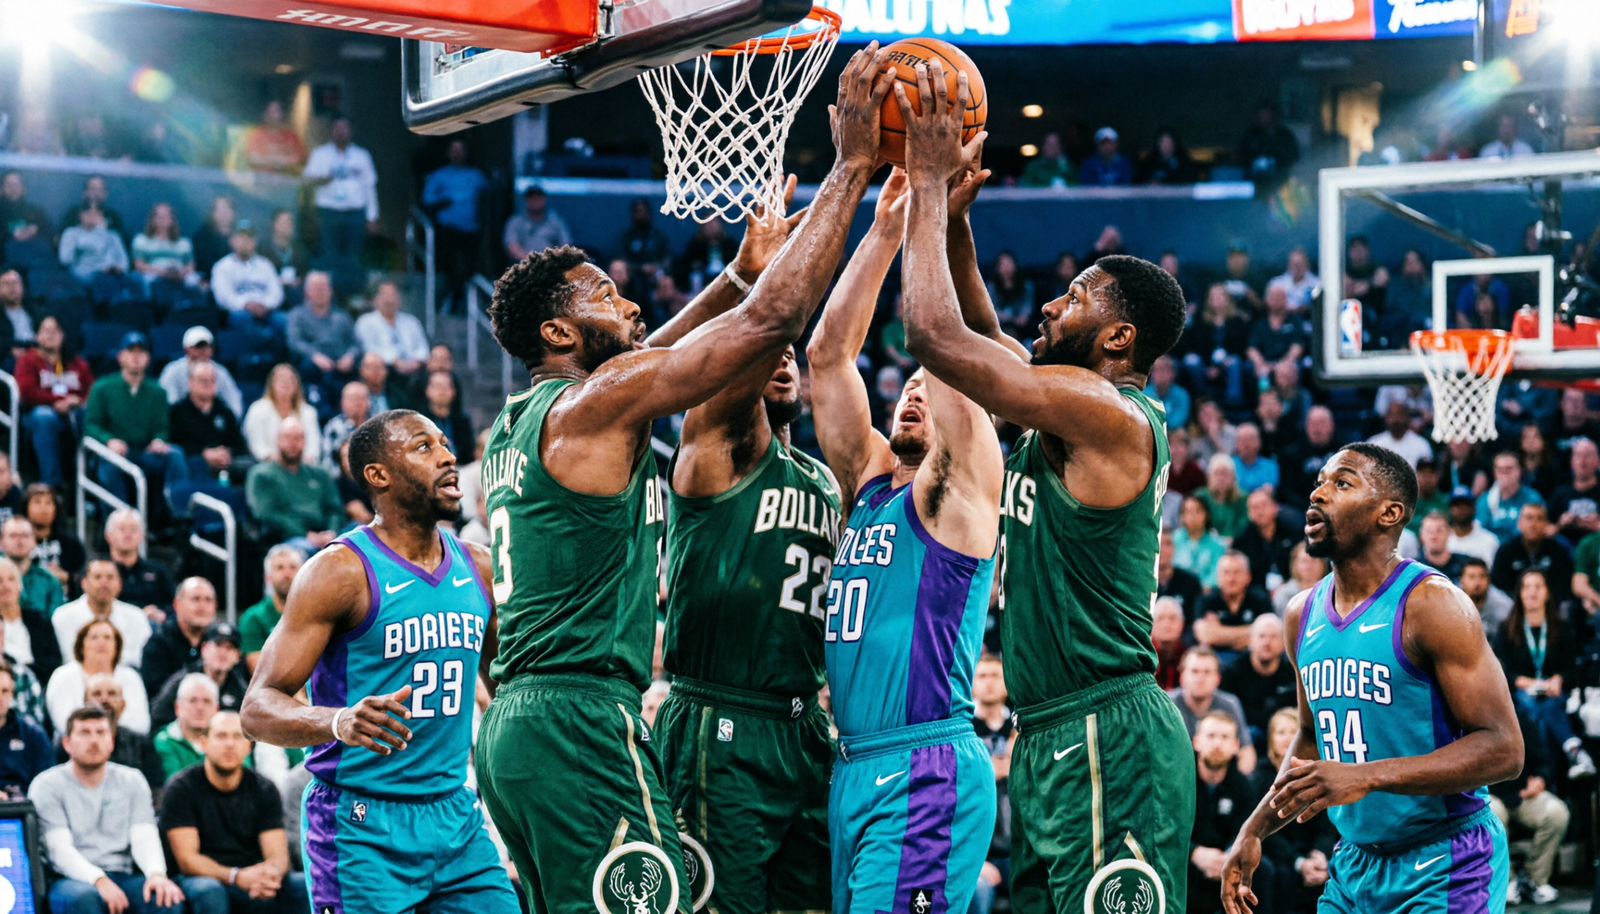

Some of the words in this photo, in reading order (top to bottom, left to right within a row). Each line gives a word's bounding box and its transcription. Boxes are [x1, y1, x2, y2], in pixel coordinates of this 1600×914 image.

[779, 543, 832, 622] 22
[825, 578, 868, 641] 20
[411, 660, 463, 718] 23
[1317, 709, 1368, 764] 34
